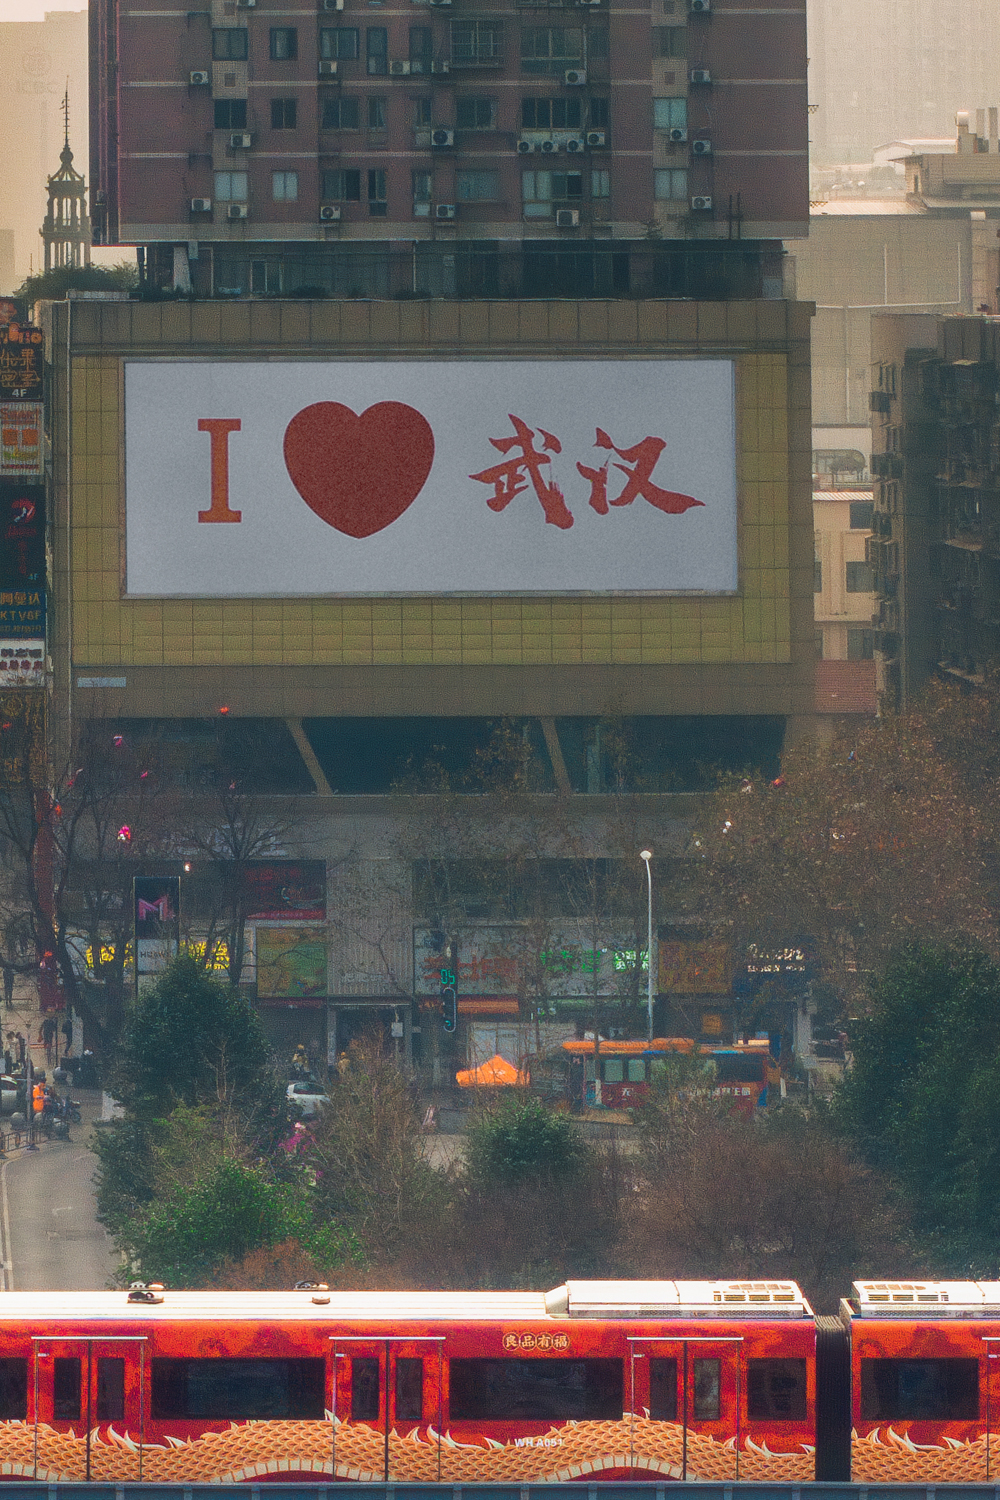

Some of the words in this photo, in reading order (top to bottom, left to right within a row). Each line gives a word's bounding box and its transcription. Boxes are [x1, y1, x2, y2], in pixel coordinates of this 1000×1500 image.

[12, 388, 27, 398] 4F
[197, 418, 242, 523] I
[468, 413, 706, 530] 武汉
[504, 1333, 569, 1349] 良品有福
